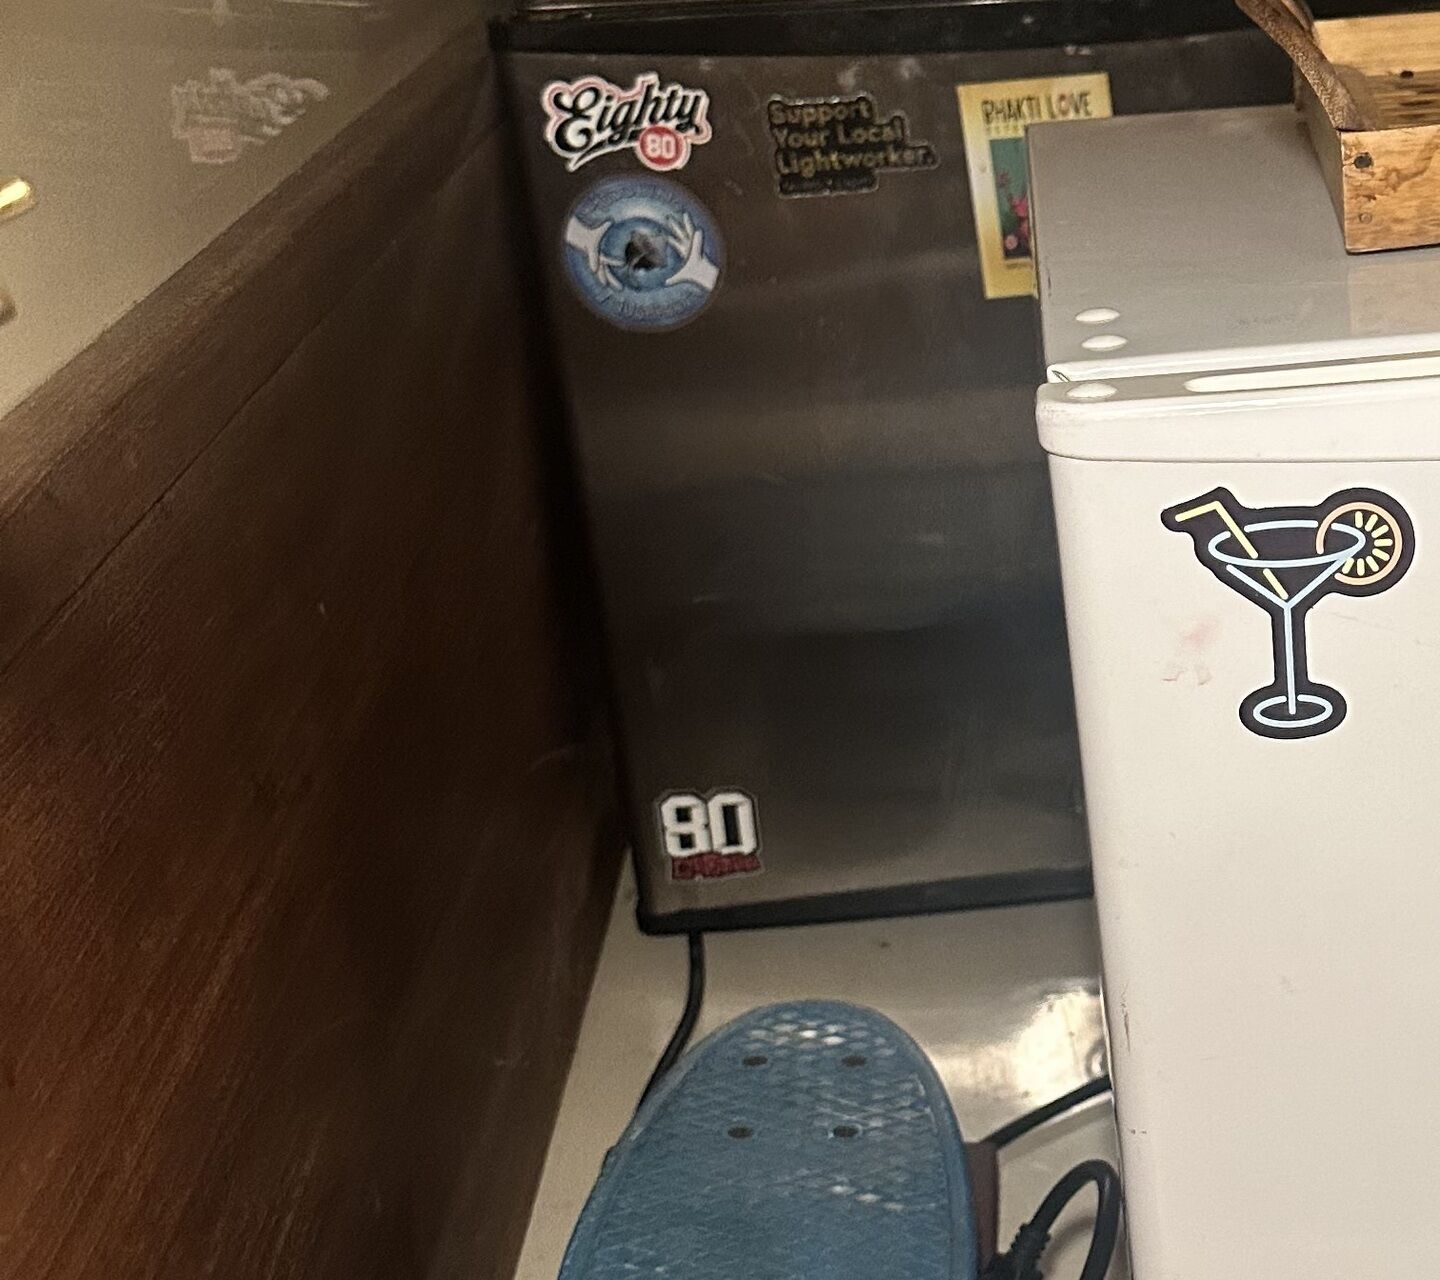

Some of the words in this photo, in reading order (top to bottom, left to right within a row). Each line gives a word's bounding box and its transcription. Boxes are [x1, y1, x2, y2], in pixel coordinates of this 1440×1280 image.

[769, 97, 873, 128] Support
[1046, 91, 1093, 119] LOVE
[552, 83, 702, 166] Eighty
[772, 127, 830, 148] Your
[837, 116, 904, 144] Local
[648, 132, 677, 160] 80
[660, 792, 757, 858] 80
